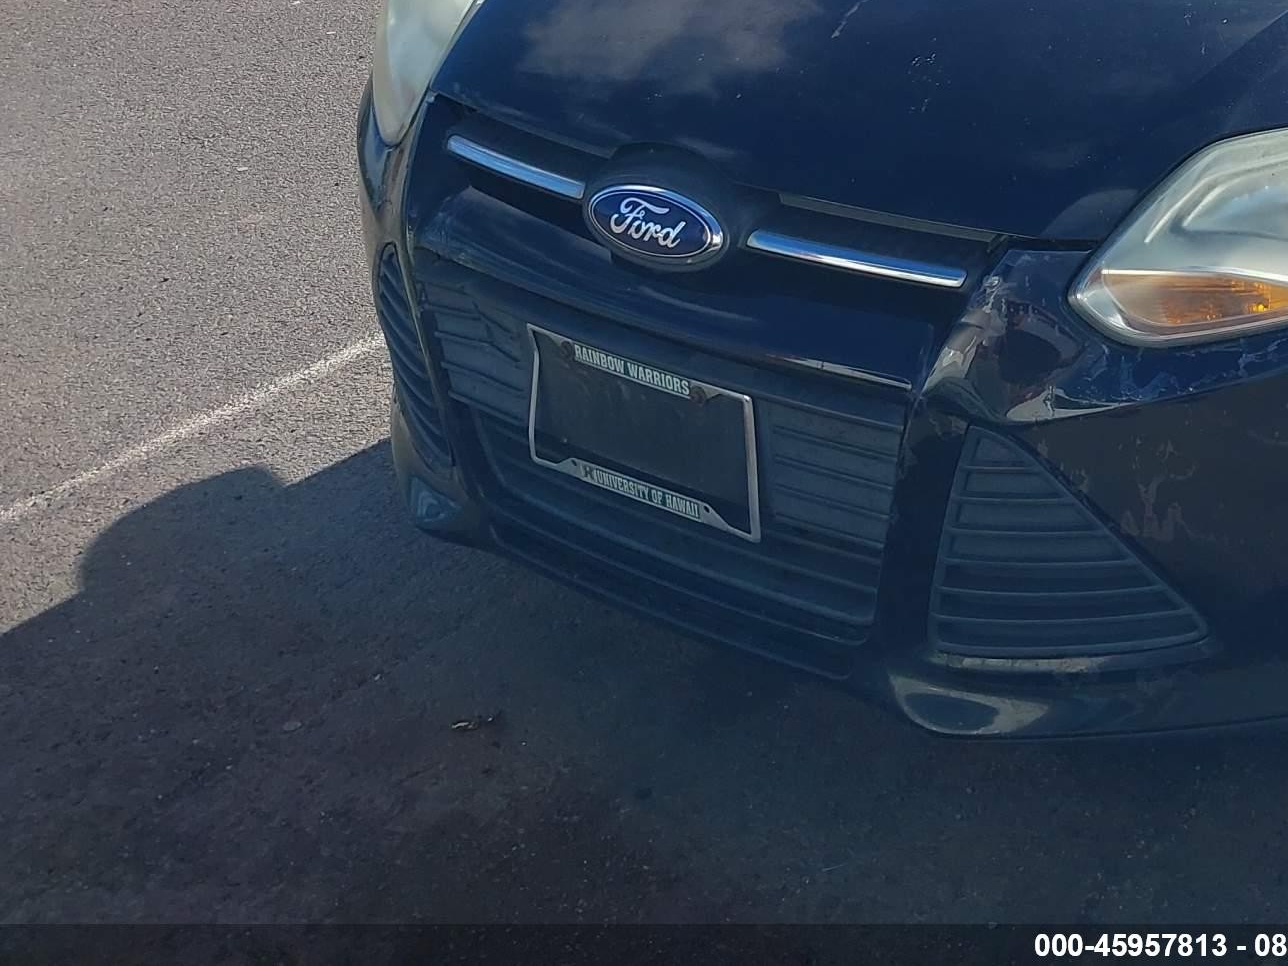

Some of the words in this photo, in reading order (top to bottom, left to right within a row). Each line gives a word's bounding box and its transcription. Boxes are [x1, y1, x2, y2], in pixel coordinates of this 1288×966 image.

[610, 197, 687, 248] Ford
[574, 344, 625, 375] RAINBOW
[627, 362, 690, 395] WARRIORS
[596, 469, 650, 501] UNIVERSITY
[651, 487, 663, 504] OF
[665, 493, 699, 518] HAWAII
